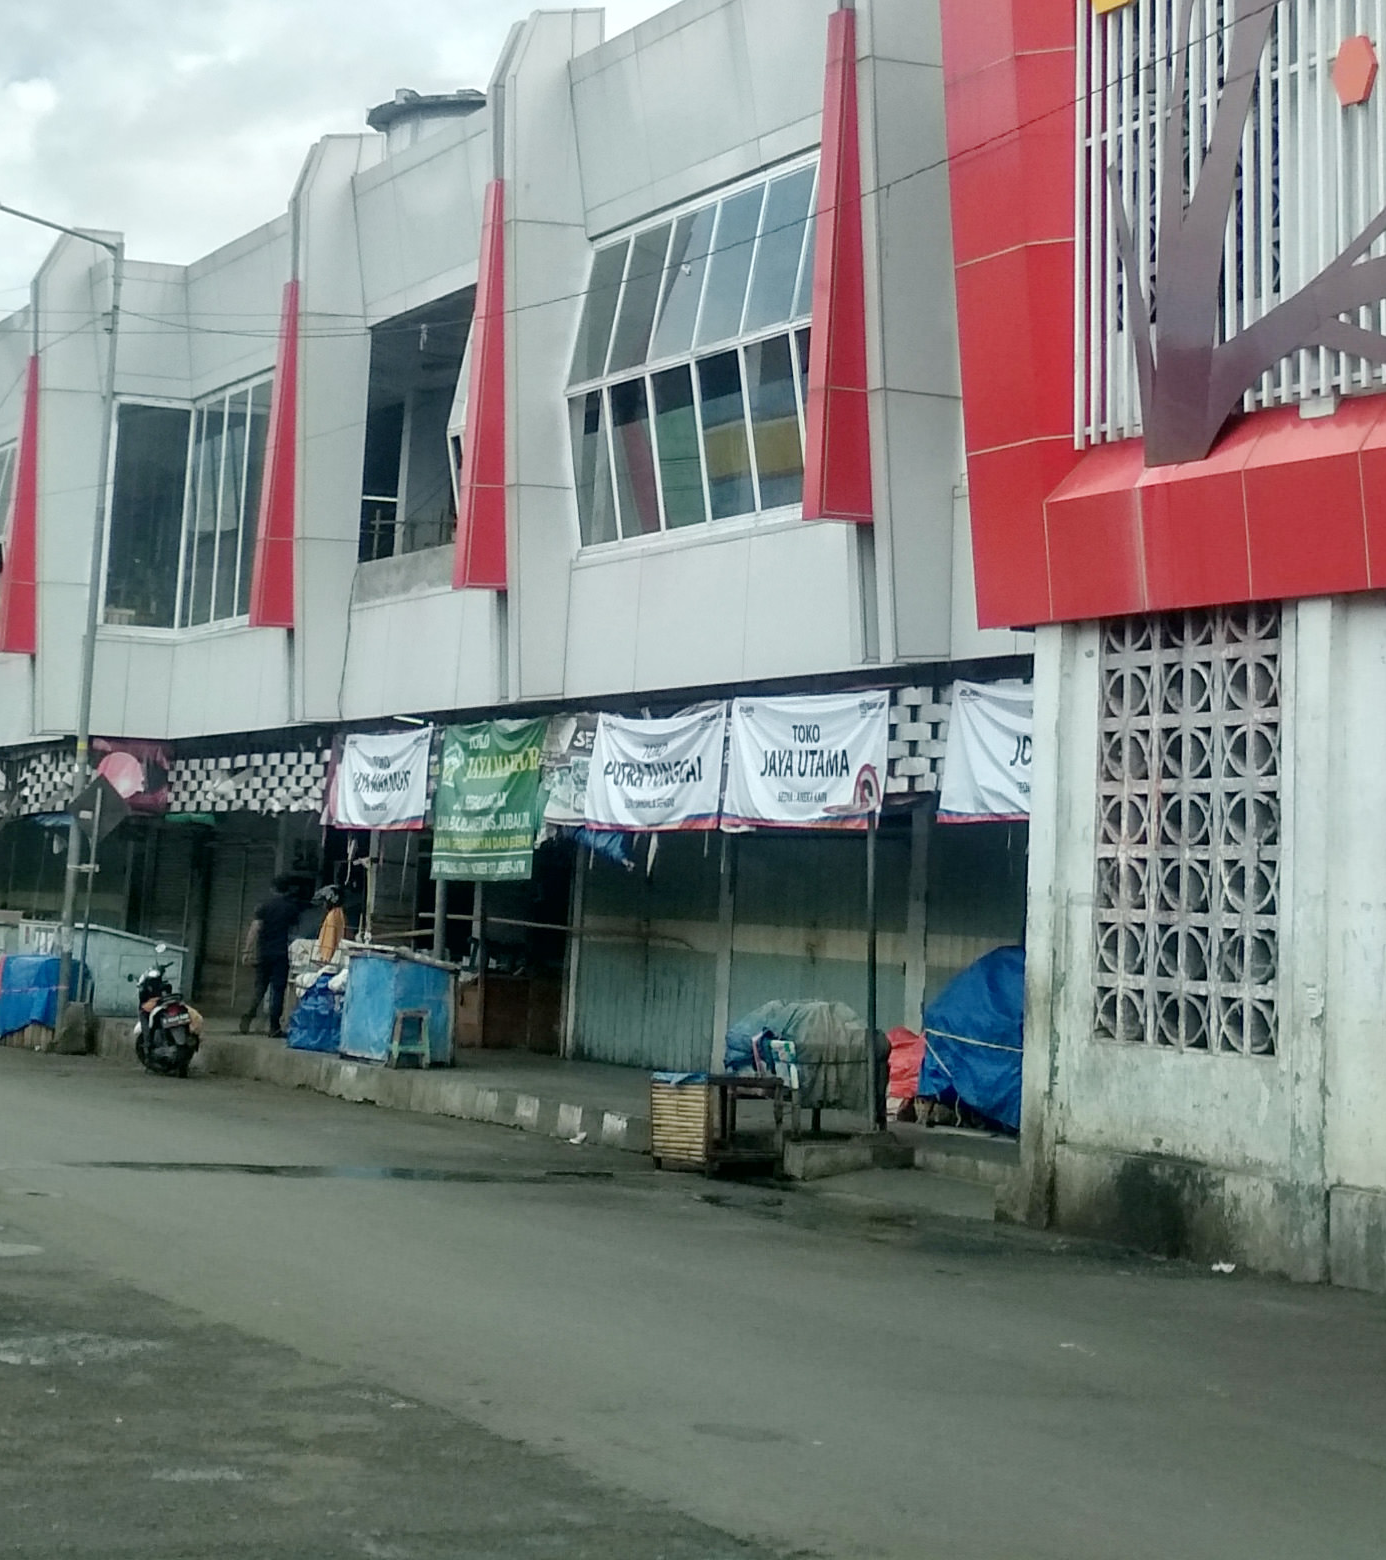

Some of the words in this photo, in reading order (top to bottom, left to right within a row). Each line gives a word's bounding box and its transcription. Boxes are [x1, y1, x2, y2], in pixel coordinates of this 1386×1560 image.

[792, 724, 821, 743] TOKO
[603, 760, 643, 787] PUTRA
[644, 755, 703, 787] TUNGGAL
[760, 750, 794, 777] JAYA
[798, 749, 850, 778] UTAMA
